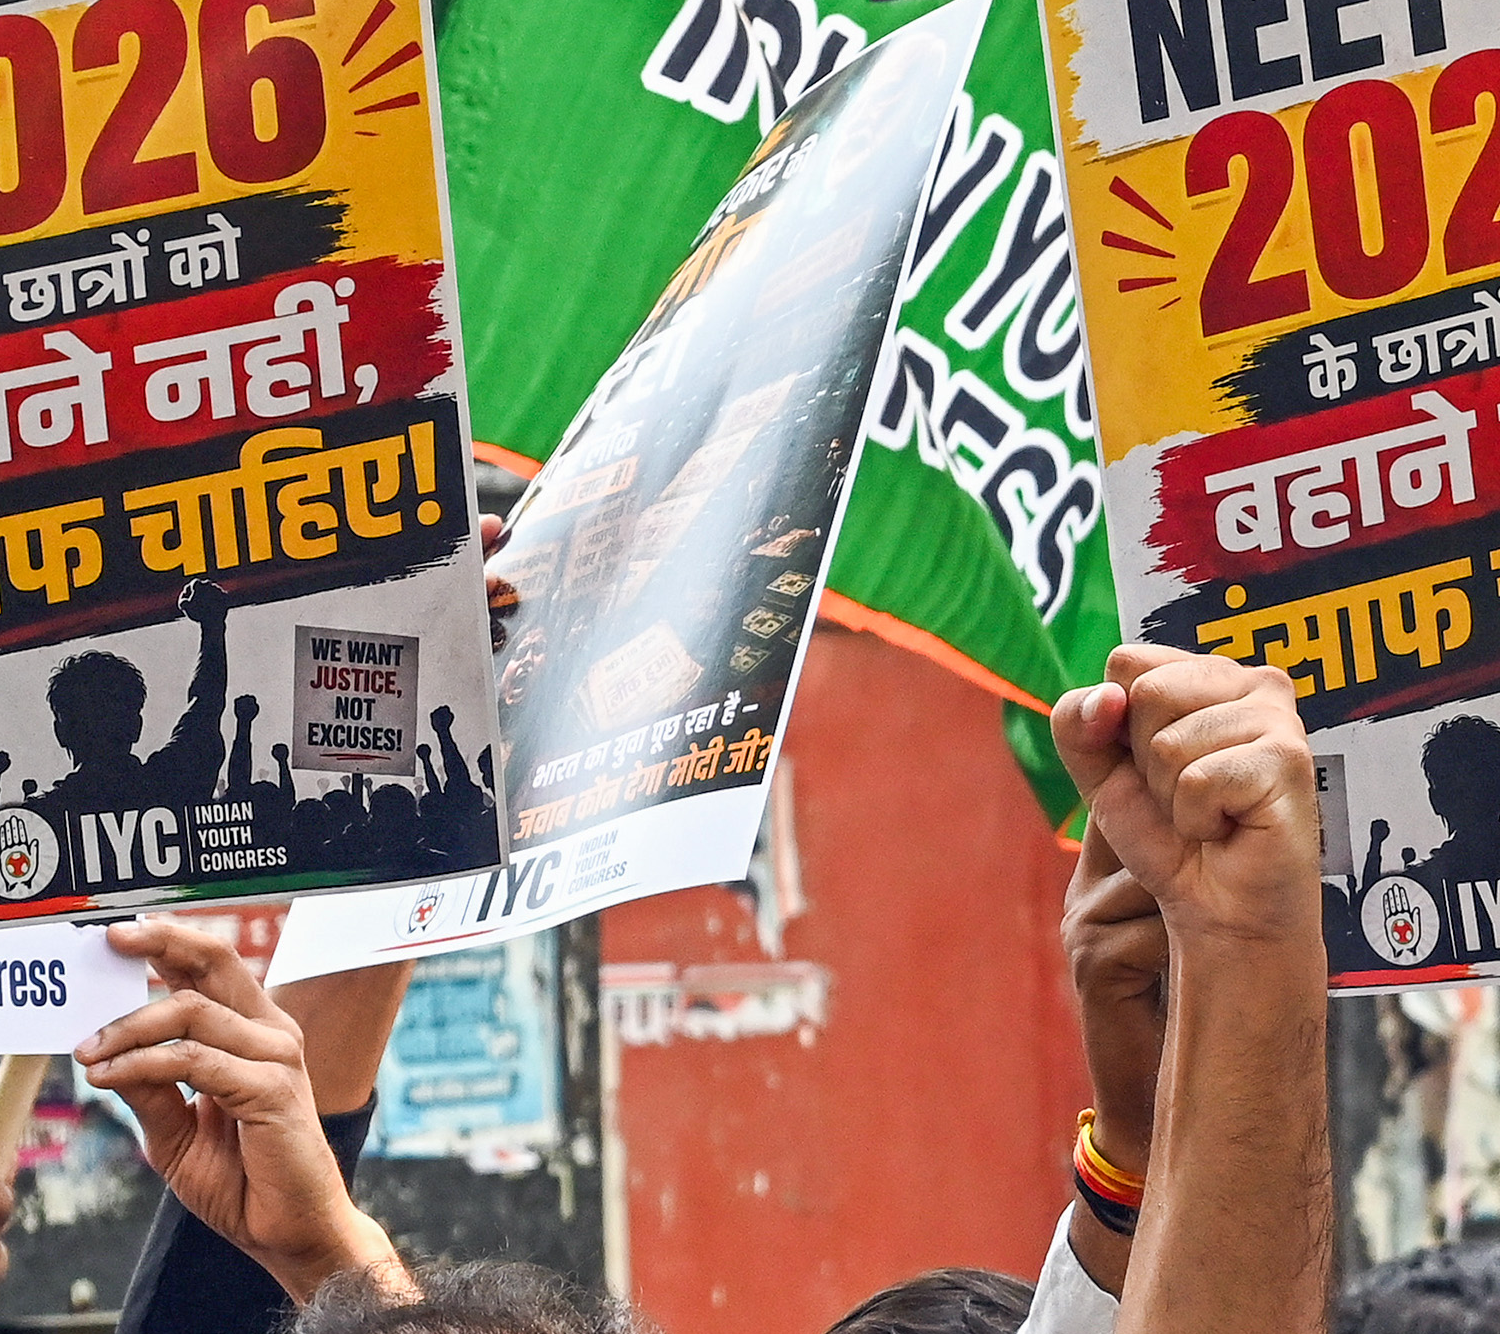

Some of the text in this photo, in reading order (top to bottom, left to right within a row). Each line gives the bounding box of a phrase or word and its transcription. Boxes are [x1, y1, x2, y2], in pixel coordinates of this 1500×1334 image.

[3, 230, 152, 323] छात्रों
[165, 214, 242, 289] को
[132, 277, 380, 422] नहीं,
[1302, 333, 1358, 401] के
[1204, 390, 1477, 554] बहाने
[123, 420, 442, 576] चाहिए!
[311, 636, 404, 668] WE WANT
[310, 666, 403, 698] JUSTICE,
[334, 696, 376, 722] NOT
[307, 723, 403, 752] EXCUSES!
[532, 689, 742, 789] भारत का युवा पूछ रहा है
[513, 727, 775, 841] जवाब कौन देगा मोदी जी?
[194, 801, 254, 826] INDIAN
[82, 806, 179, 884] IYC
[197, 826, 253, 850] YOUTH
[578, 830, 618, 855] INDIAN
[199, 845, 288, 874] CONGRESS
[575, 851, 611, 875] YOUTH
[476, 850, 562, 922] IYC
[568, 860, 627, 896] CONGRESS
